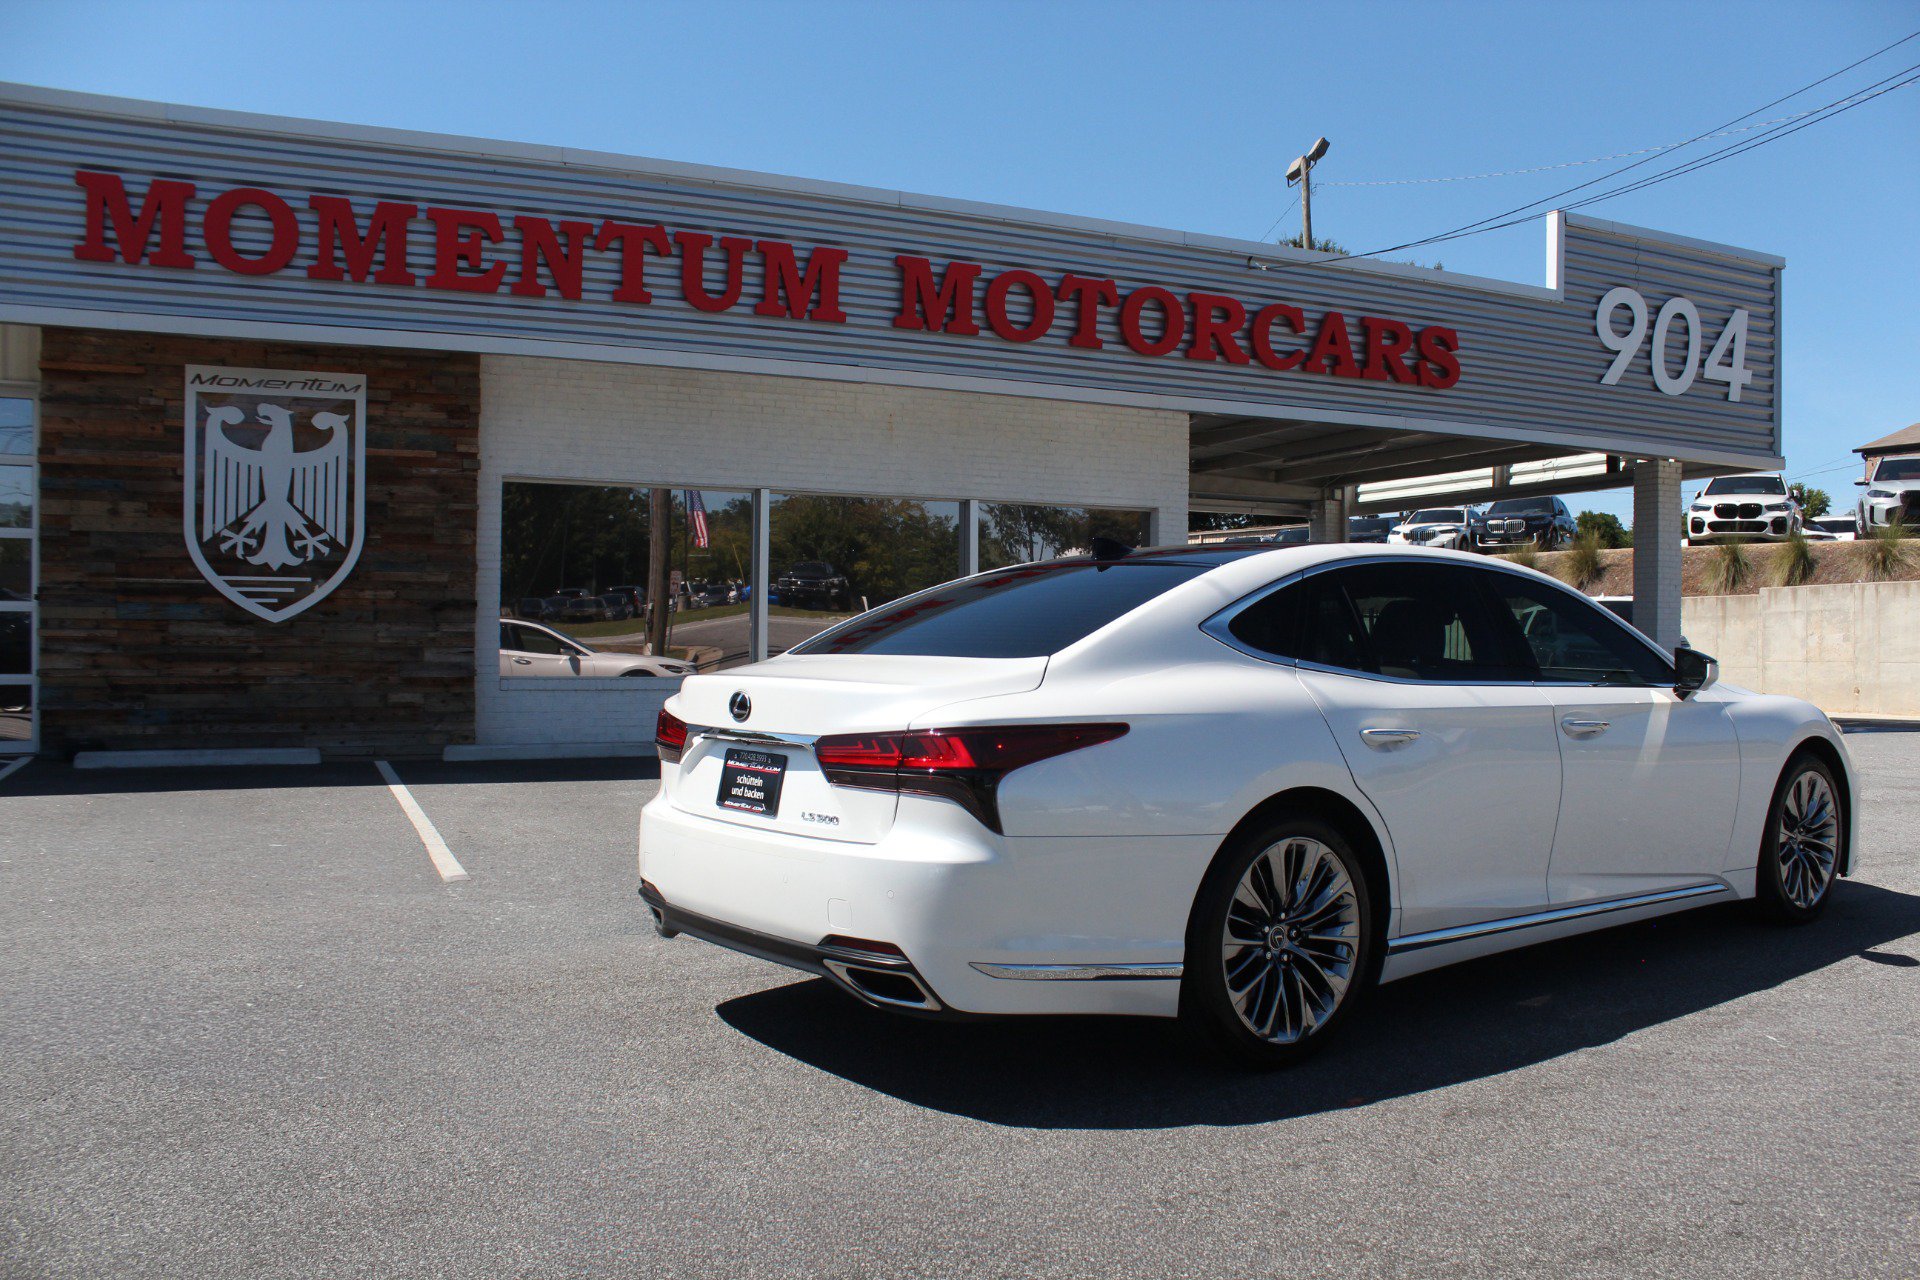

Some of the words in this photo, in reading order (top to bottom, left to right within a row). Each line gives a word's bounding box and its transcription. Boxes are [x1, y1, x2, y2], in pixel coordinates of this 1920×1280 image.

[74, 170, 848, 323] MOMENTUM
[893, 255, 1461, 389] MOTORCARS
[1596, 287, 1752, 401] 904
[731, 786, 744, 796] und
[744, 786, 765, 800] backen
[736, 774, 764, 787] schütteln
